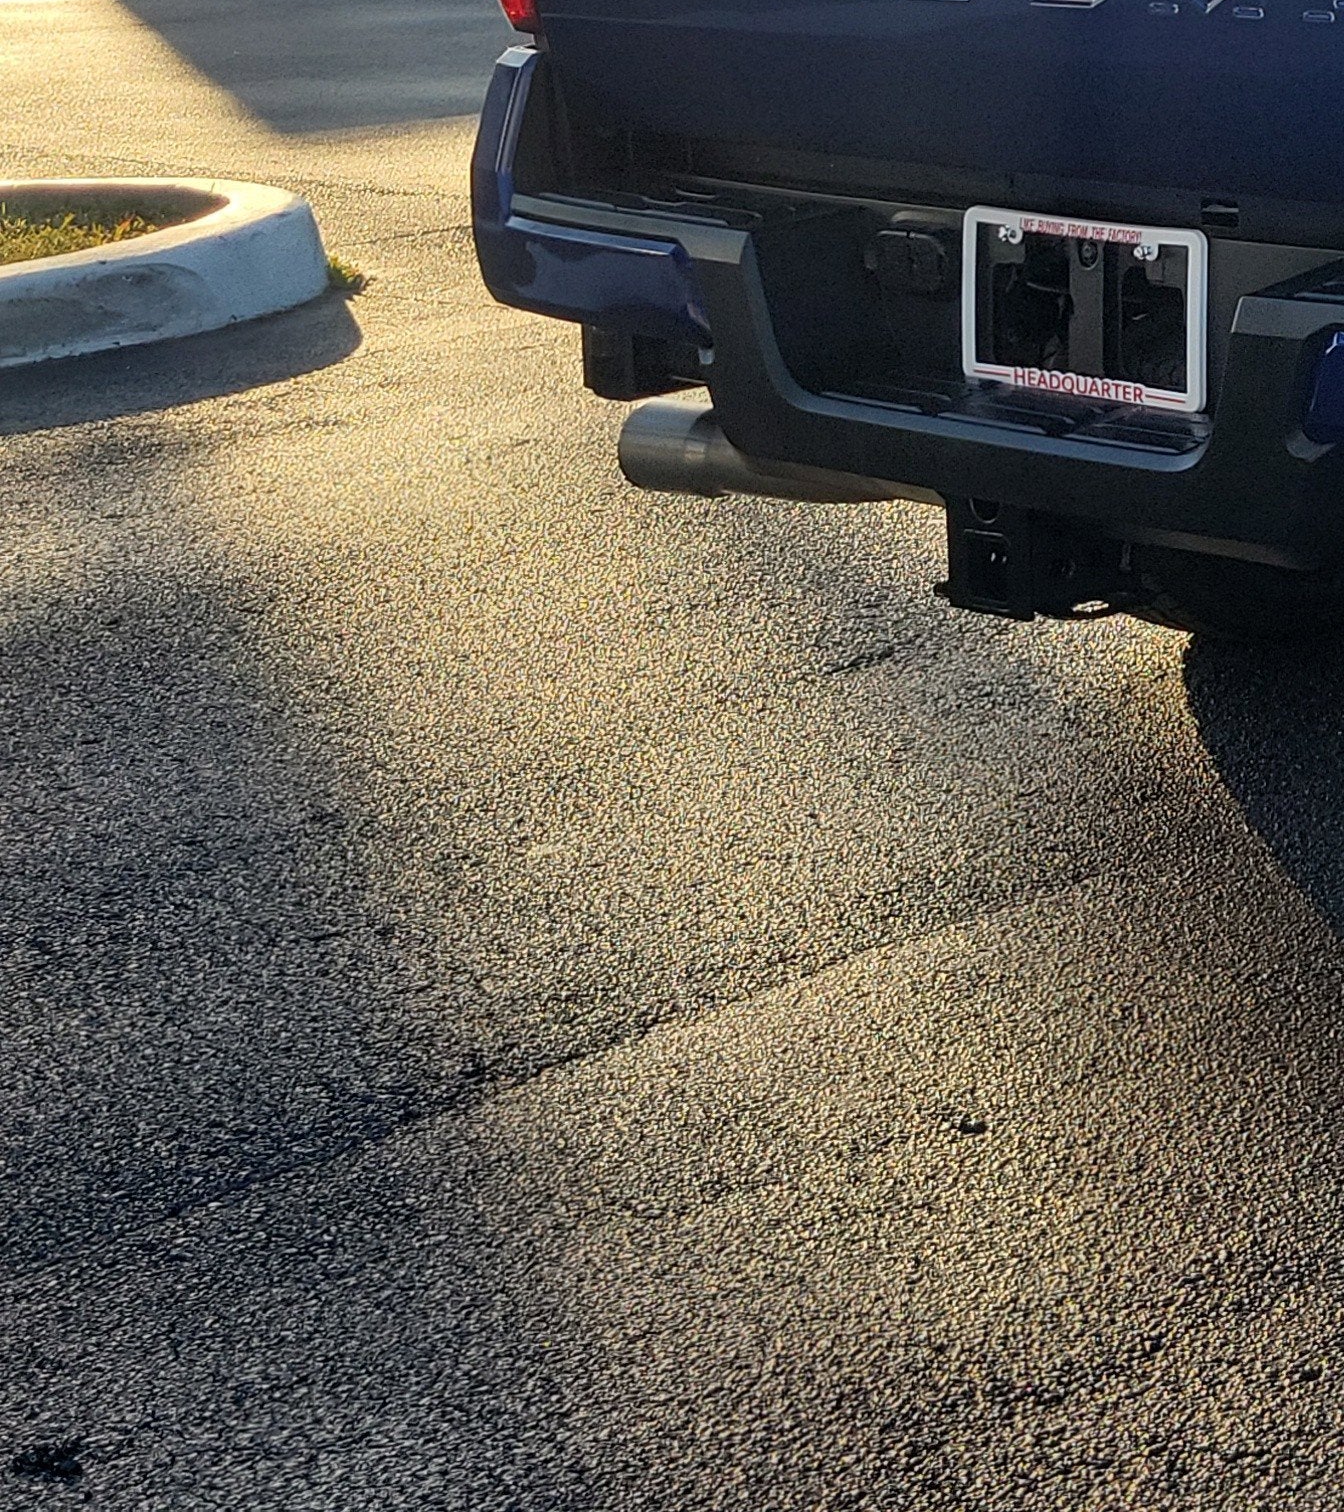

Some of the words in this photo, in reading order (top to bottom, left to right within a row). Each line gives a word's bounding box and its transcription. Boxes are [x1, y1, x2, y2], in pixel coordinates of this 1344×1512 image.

[1020, 217, 1034, 232] LIKE
[1037, 219, 1065, 235] BUYING
[1067, 223, 1089, 238] FROM
[1092, 225, 1106, 239] THE
[1013, 366, 1144, 403] HEADQUARTER
